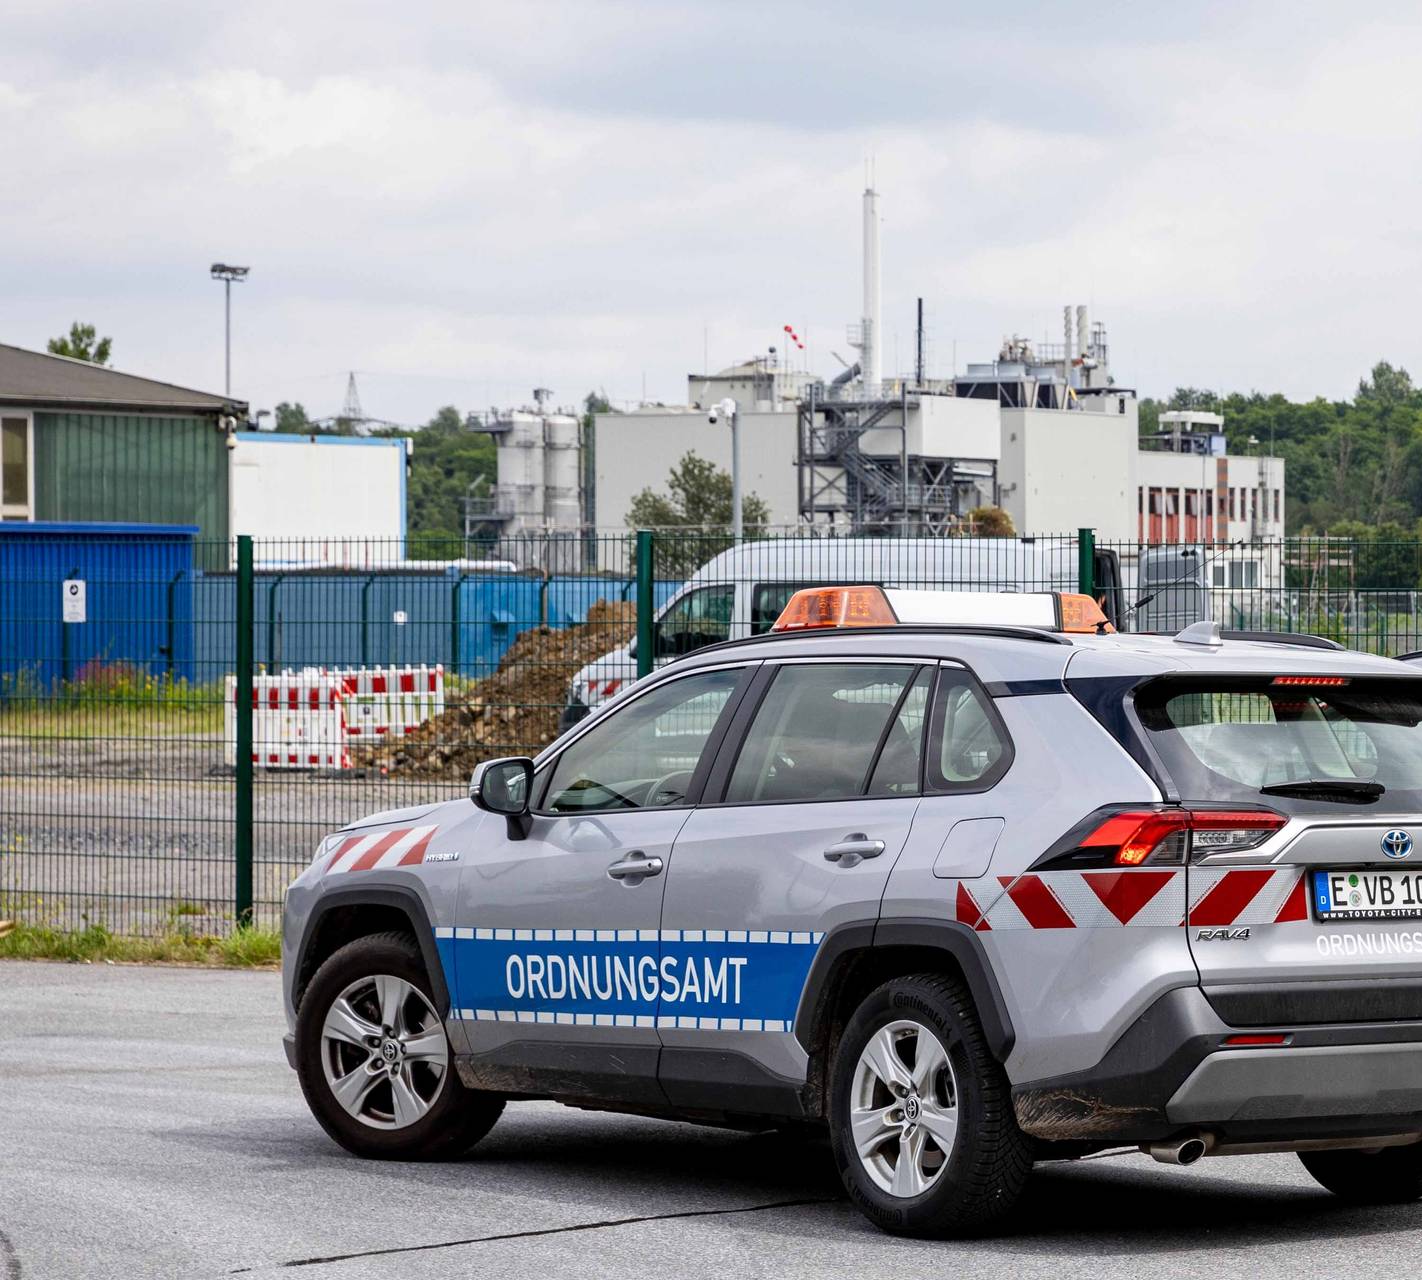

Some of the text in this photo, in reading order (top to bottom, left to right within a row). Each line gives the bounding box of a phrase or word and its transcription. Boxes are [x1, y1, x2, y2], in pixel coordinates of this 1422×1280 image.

[1320, 895, 1327, 905] D
[1331, 876, 1348, 907] E
[1363, 873, 1395, 906] VB
[1195, 927, 1252, 942] RAV4
[505, 954, 748, 1004] ORDNUNGSAMT
